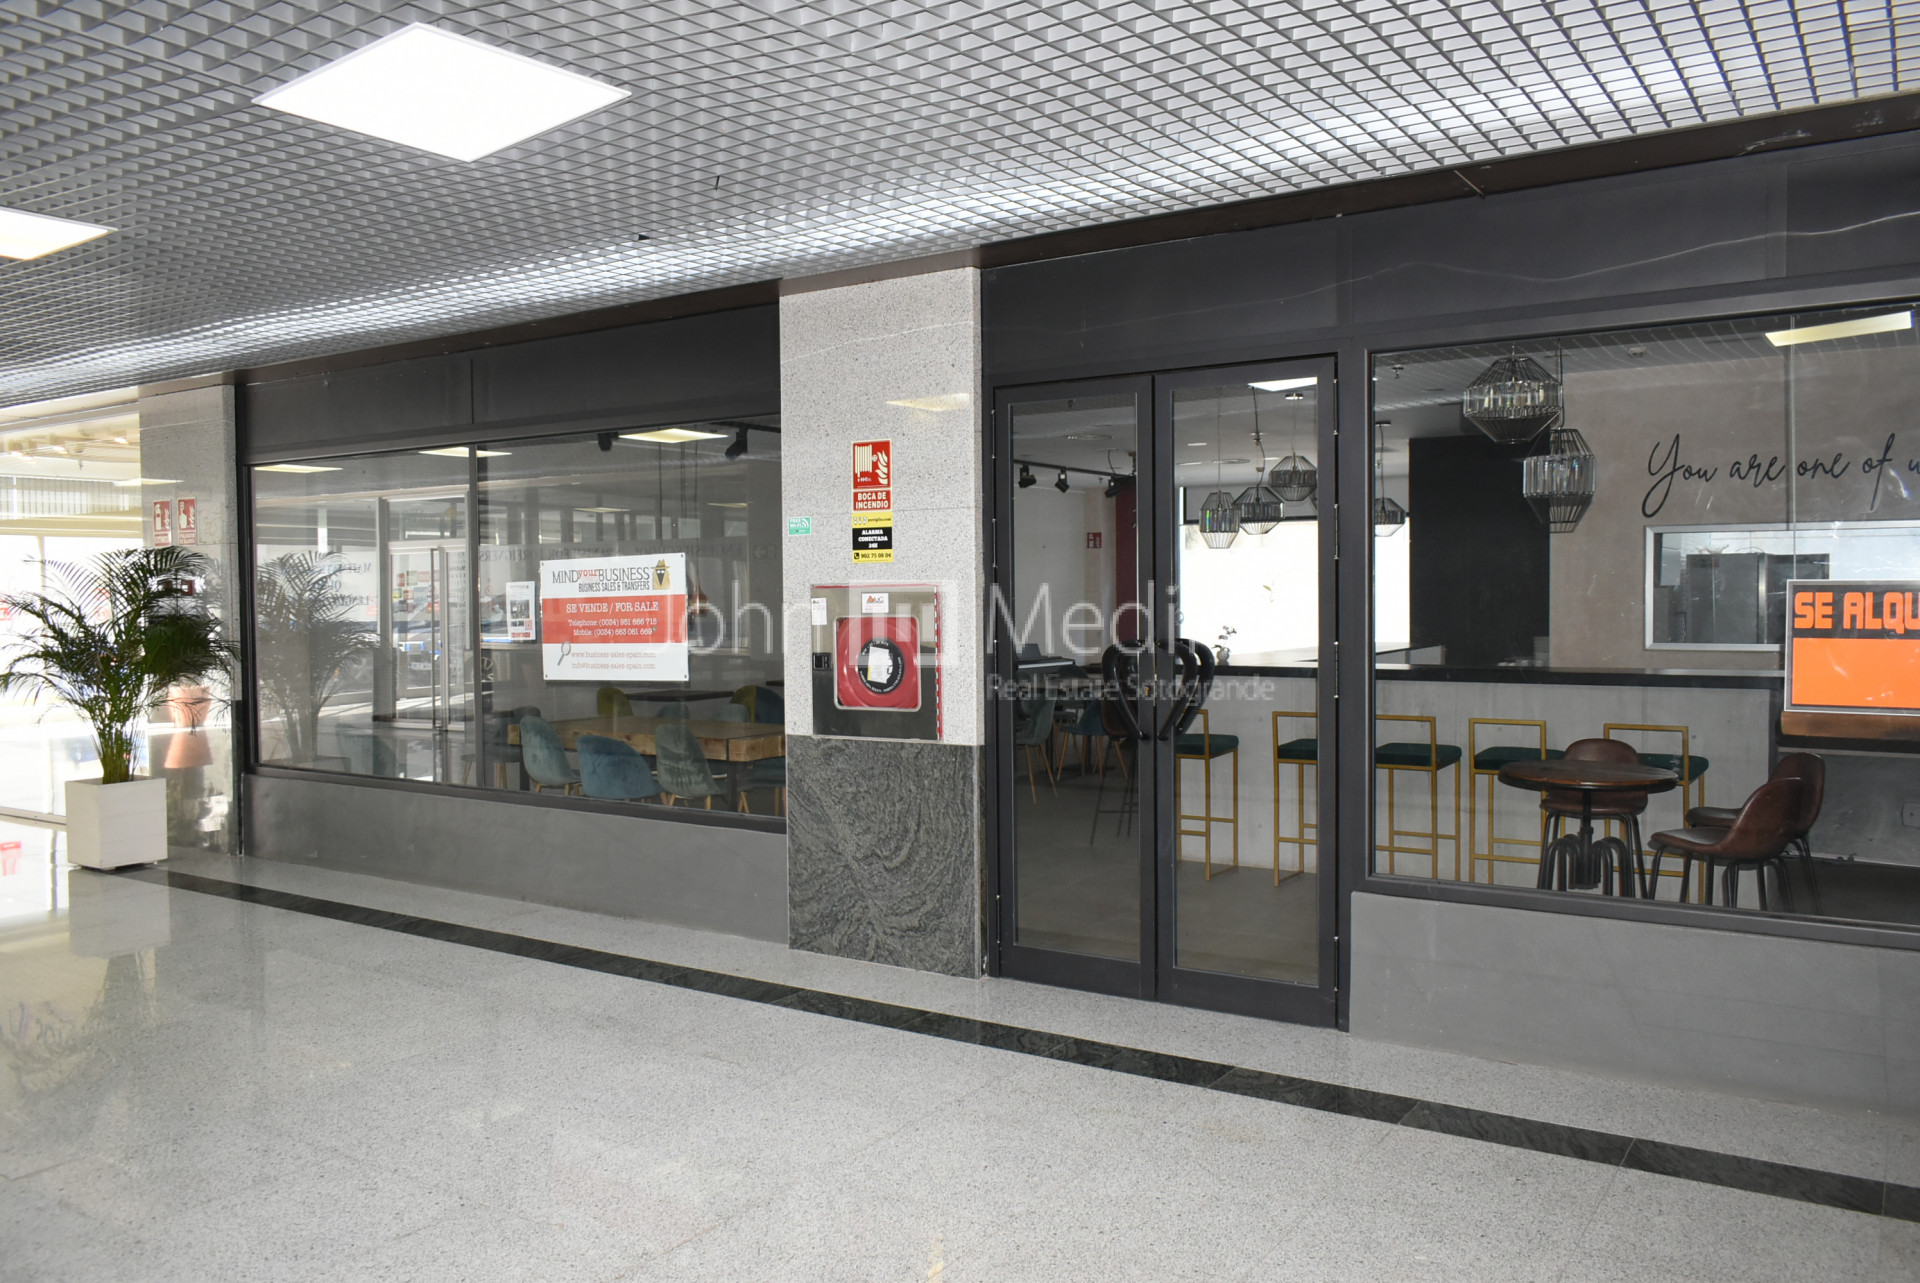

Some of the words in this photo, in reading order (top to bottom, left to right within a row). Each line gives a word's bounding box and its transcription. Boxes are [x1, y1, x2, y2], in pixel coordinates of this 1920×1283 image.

[1641, 433, 1718, 518] You
[1729, 454, 1786, 487] are
[1797, 453, 1850, 479] one
[1862, 432, 1895, 511] of
[858, 493, 876, 501] BOCA
[877, 492, 887, 500] DE
[856, 500, 889, 509] INCENDIO
[579, 583, 600, 592] BUSINESS
[602, 582, 616, 591] SALES
[622, 581, 650, 591] TRANSFERS
[566, 603, 577, 613] SE
[579, 602, 608, 613] VENDE
[615, 602, 633, 612] FOR
[635, 601, 659, 612] SALE
[1794, 591, 1834, 629] SE
[1843, 591, 1920, 634] ALQU
